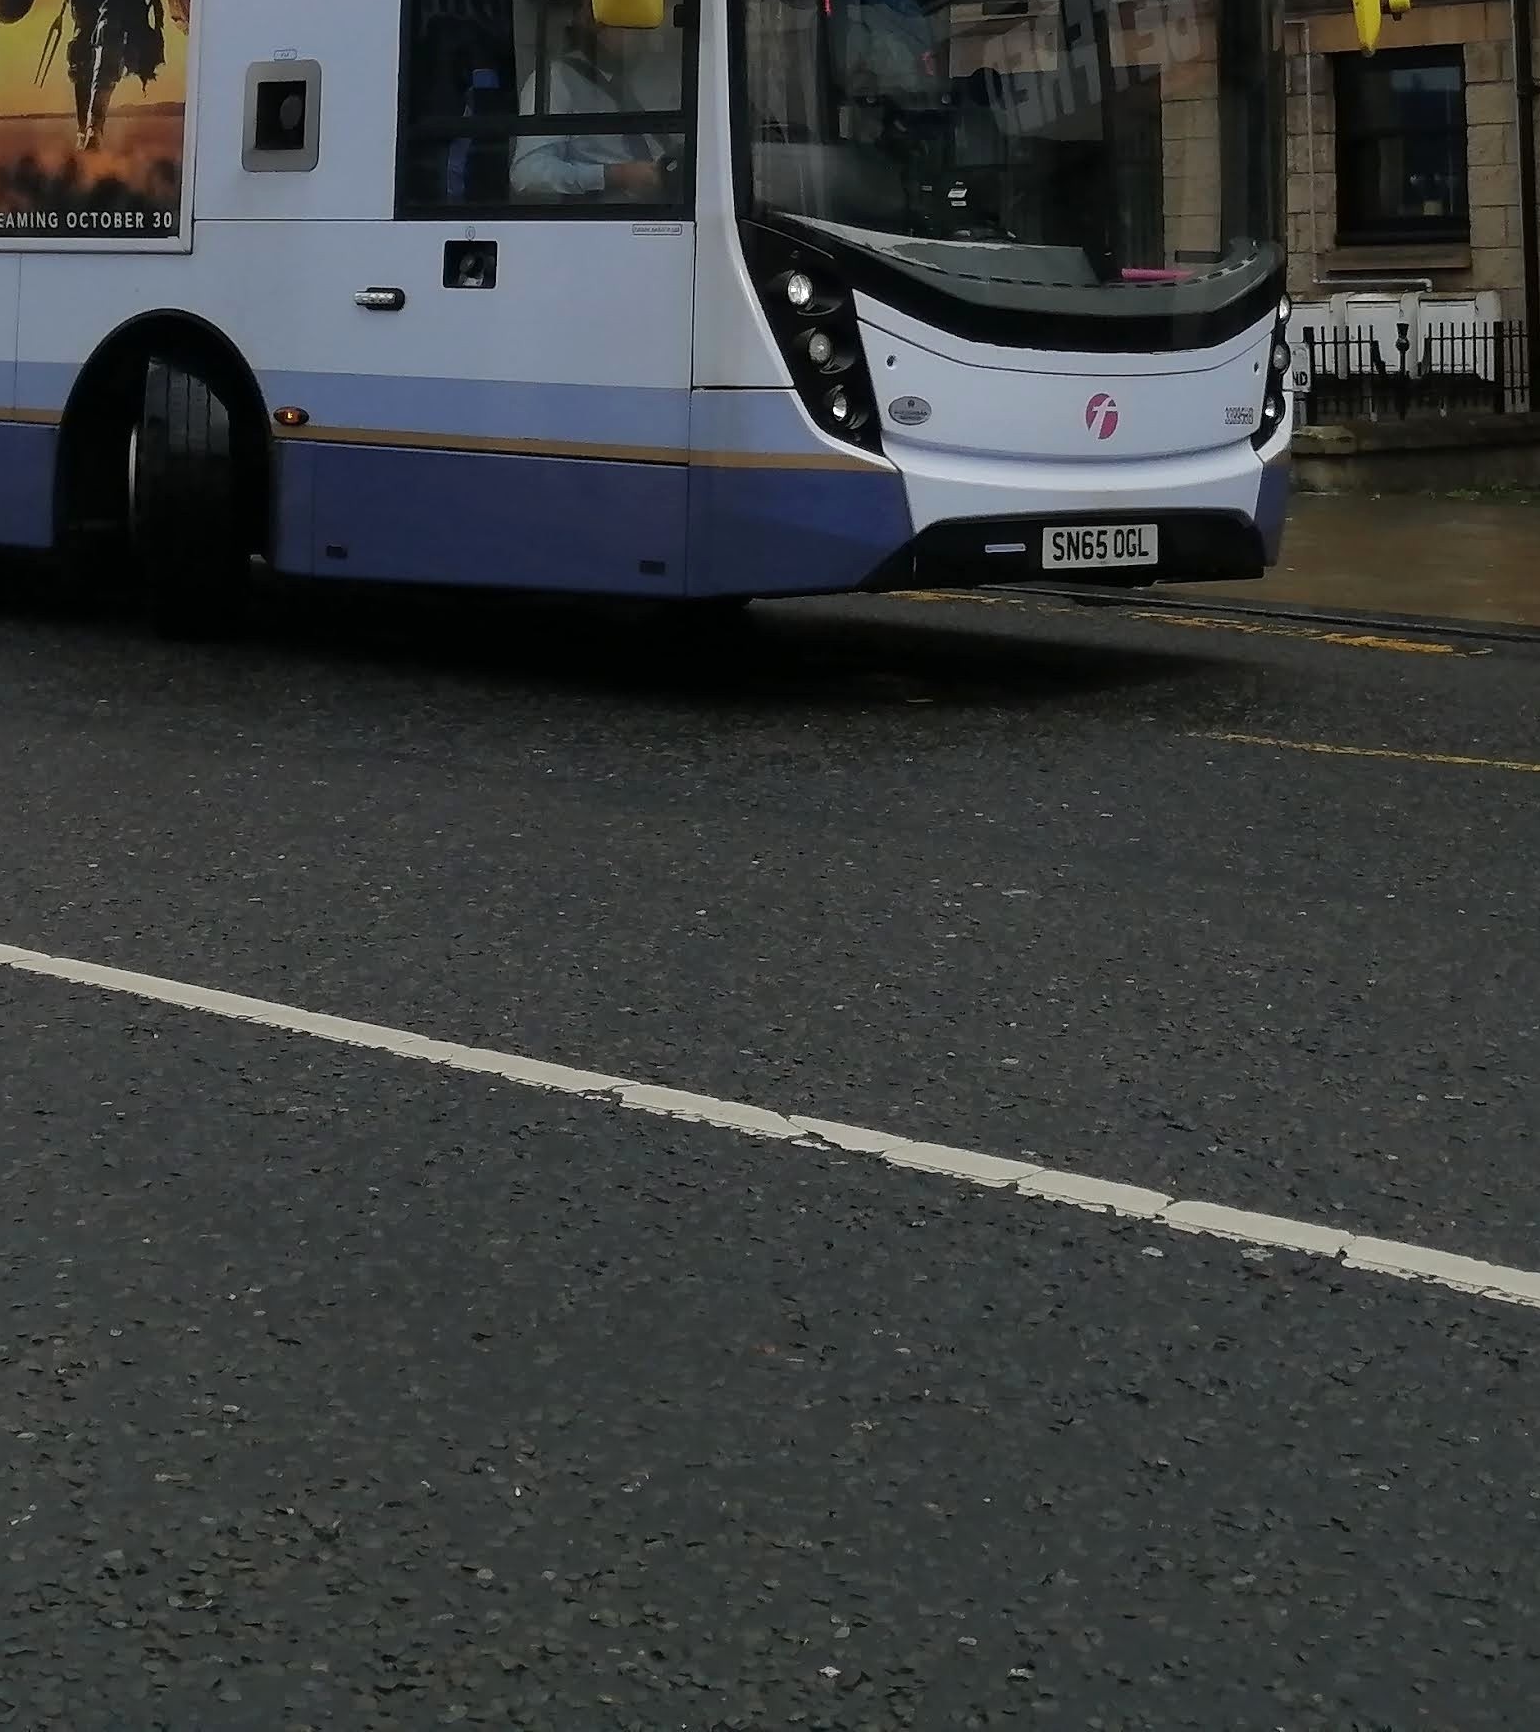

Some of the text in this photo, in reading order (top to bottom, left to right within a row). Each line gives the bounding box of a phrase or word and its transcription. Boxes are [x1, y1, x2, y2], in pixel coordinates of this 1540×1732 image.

[66, 212, 144, 229] OCTOBER
[153, 212, 172, 229] 30
[1052, 528, 1149, 561] SN65 OGL
